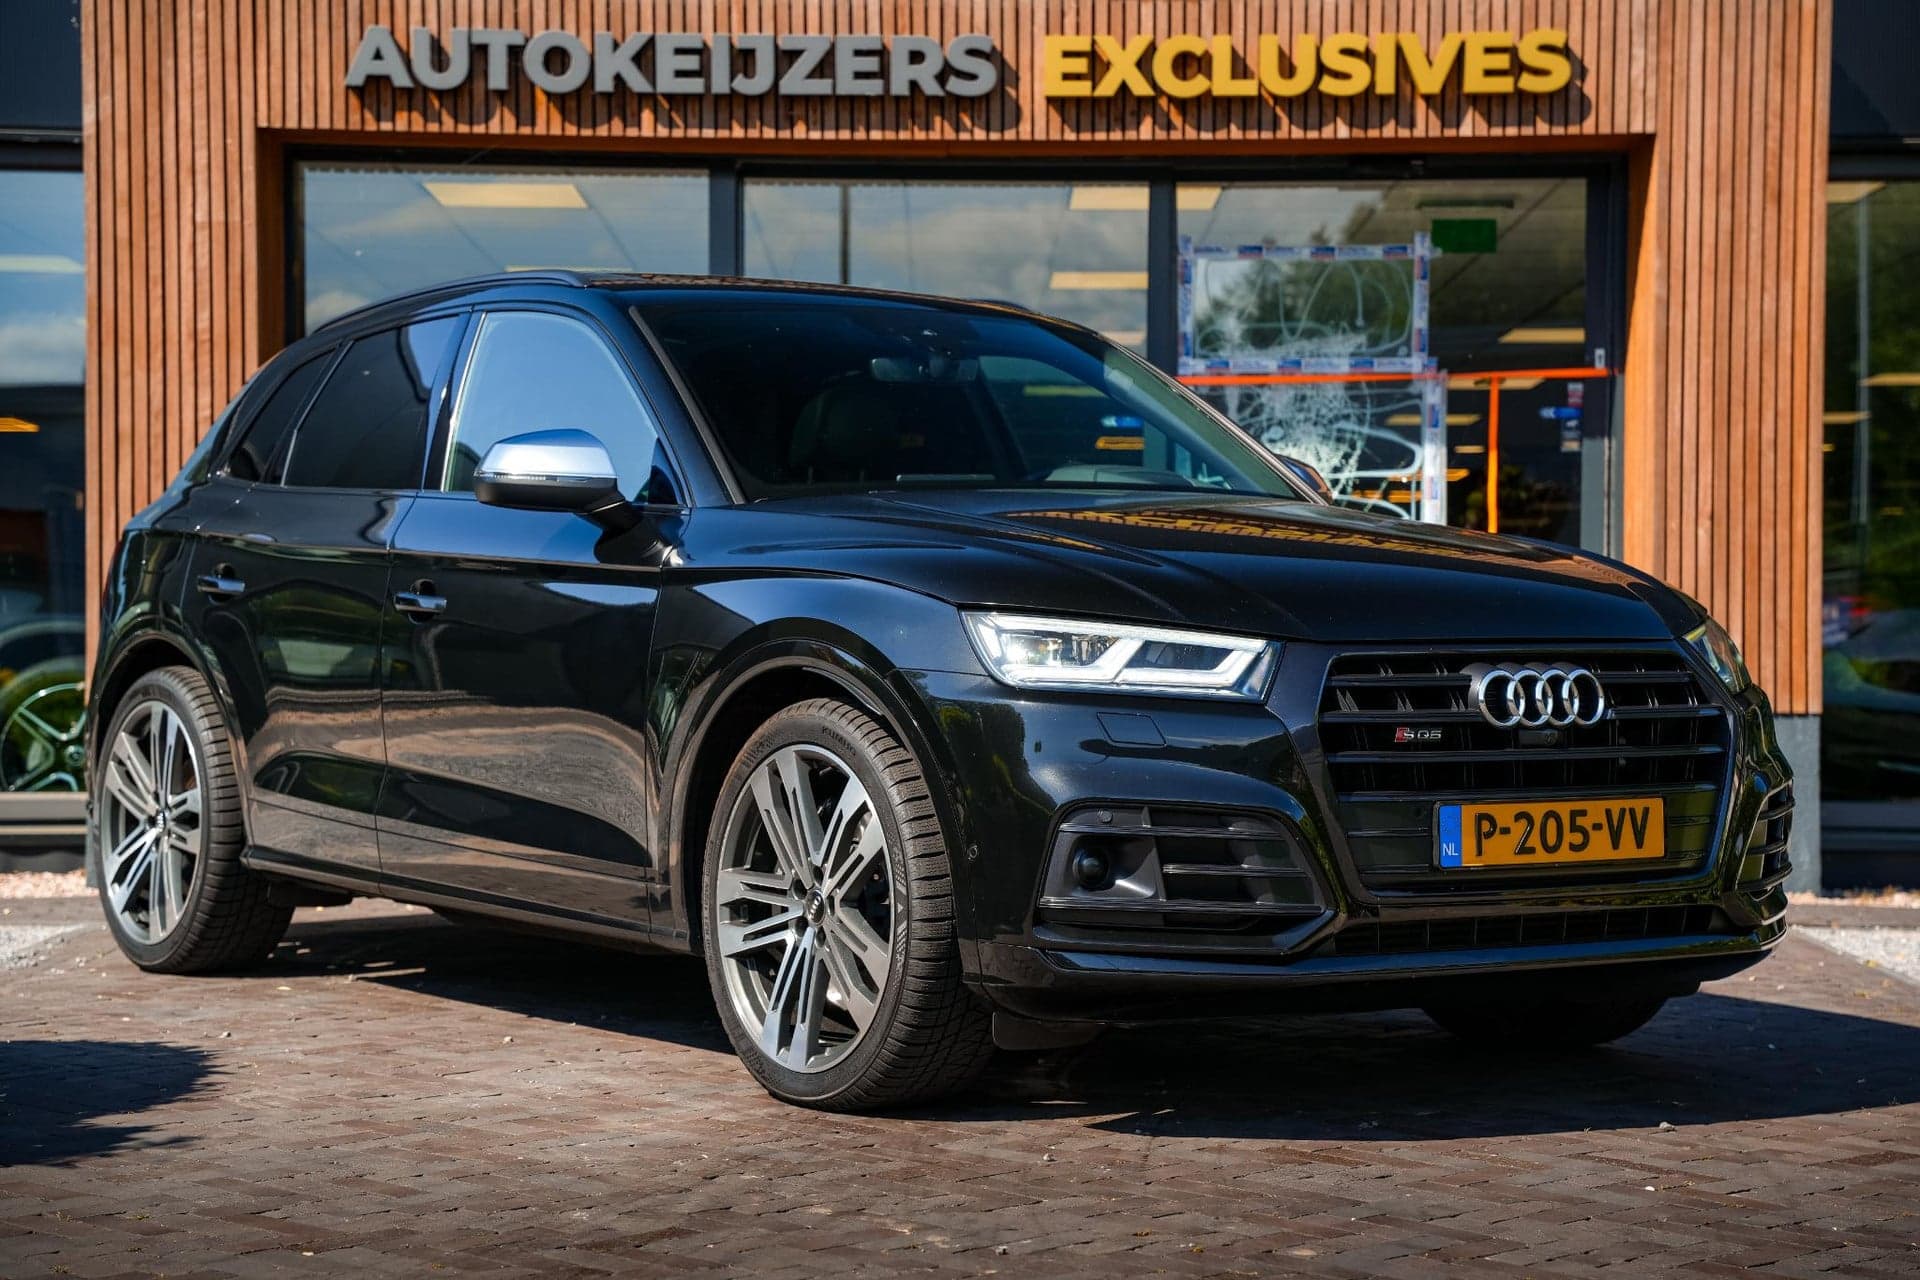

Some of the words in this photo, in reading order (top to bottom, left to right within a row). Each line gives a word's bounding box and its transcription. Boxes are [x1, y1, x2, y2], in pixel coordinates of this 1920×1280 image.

[345, 25, 998, 98] AUTOKEIJZERS
[1044, 29, 1572, 98] EXCLUSIVES
[1399, 728, 1442, 742] SQ5
[1475, 806, 1650, 857] P-205-VV
[1442, 843, 1459, 857] NL
